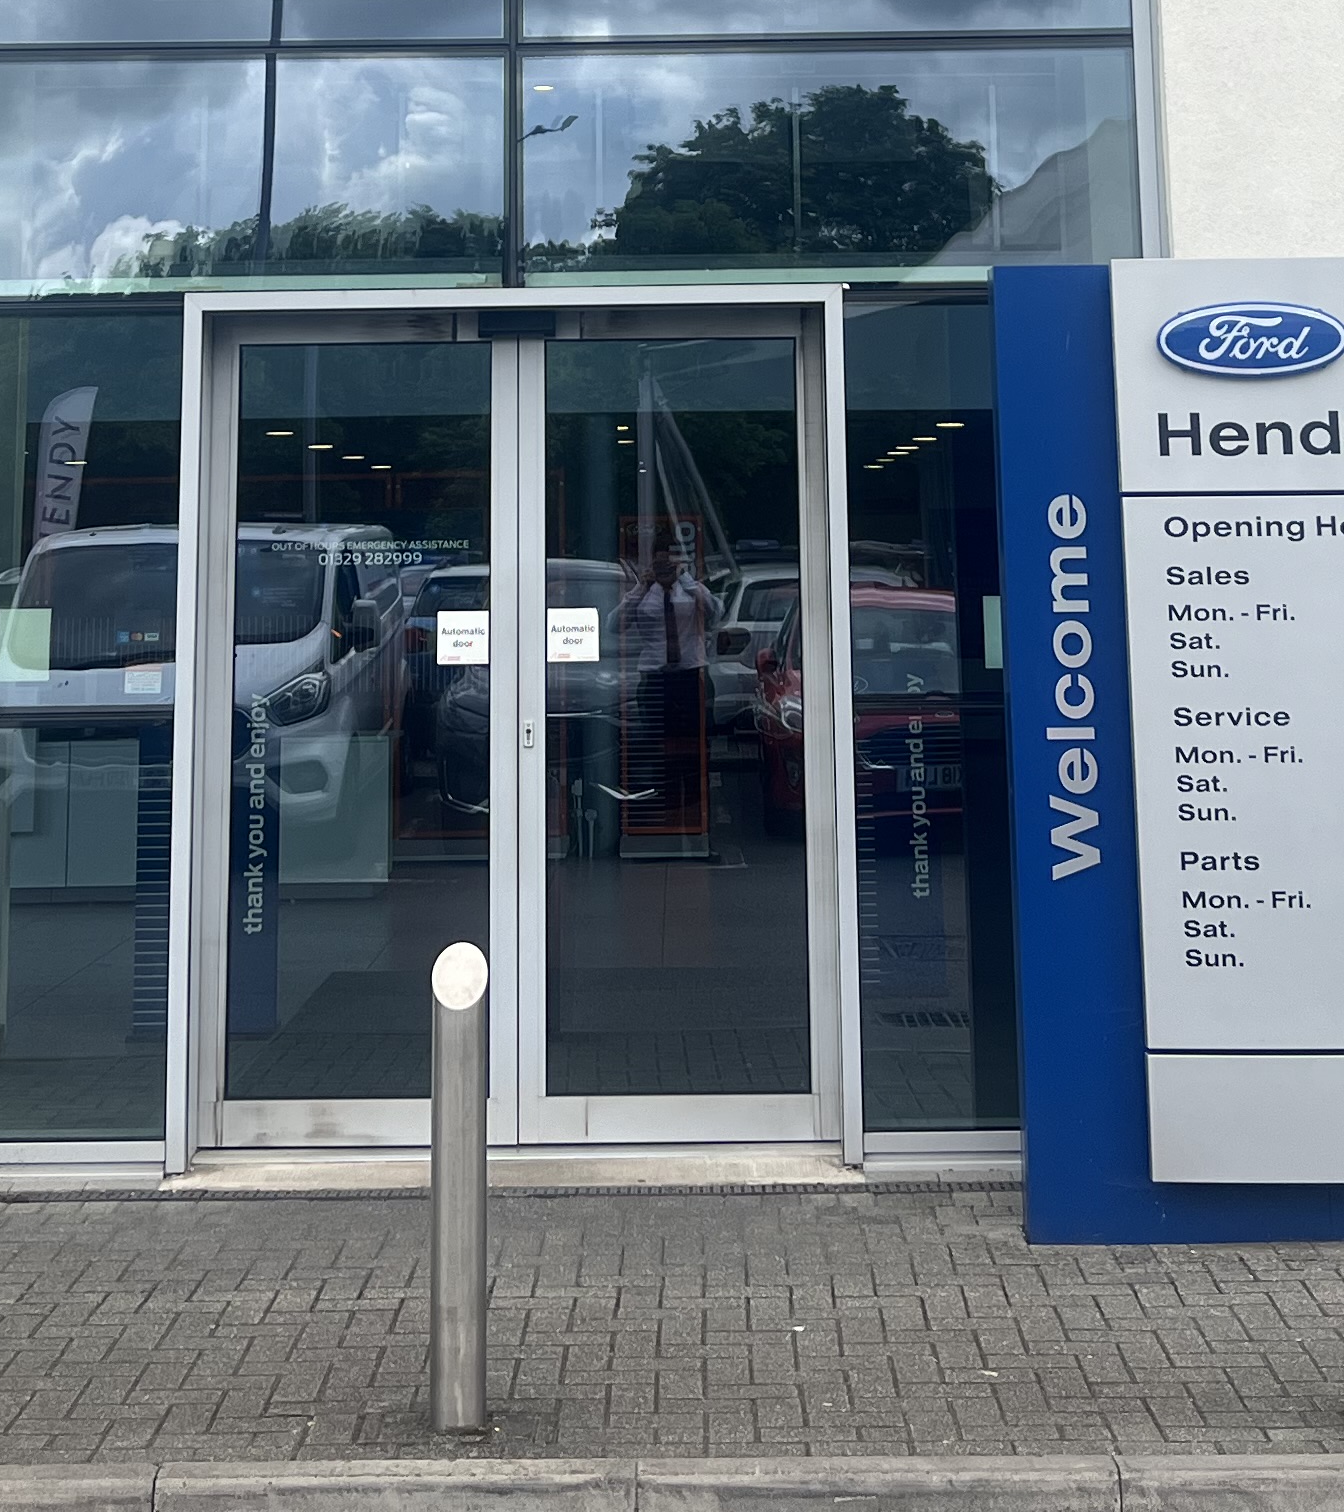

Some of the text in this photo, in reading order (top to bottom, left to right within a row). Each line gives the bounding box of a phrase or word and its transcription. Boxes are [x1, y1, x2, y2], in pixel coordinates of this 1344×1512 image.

[1198, 314, 1311, 361] Ford
[39, 416, 80, 537] ENDY
[1163, 515, 1306, 543] Opening
[271, 542, 293, 551] OUT
[346, 541, 407, 551] EMERGENCY
[408, 540, 469, 549] ASSISTANCE
[365, 552, 423, 565] 282999
[1166, 566, 1250, 586] Sales
[1168, 604, 1234, 622] Mon.
[1256, 603, 1295, 621] Fri.
[441, 627, 485, 636] Automatic
[550, 624, 596, 633] Automatic
[452, 640, 473, 648] door
[562, 637, 583, 645] door
[1170, 632, 1220, 650] Sat.
[1171, 660, 1229, 678] Sun.
[1046, 493, 1102, 881] Welcome
[1173, 706, 1291, 727] Service
[1175, 746, 1242, 764] Mon.
[1263, 745, 1303, 764] Fri.
[905, 673, 932, 899] thank you and eoy
[1176, 774, 1228, 793] Sat.
[243, 693, 271, 935] thank you and enjoy
[1178, 803, 1237, 822] Sun.
[1180, 851, 1260, 871] Parts
[1182, 890, 1249, 909] Mon.
[1271, 890, 1311, 909] Fri.
[1184, 919, 1235, 938] Sat.
[1185, 948, 1244, 968] Sun.
